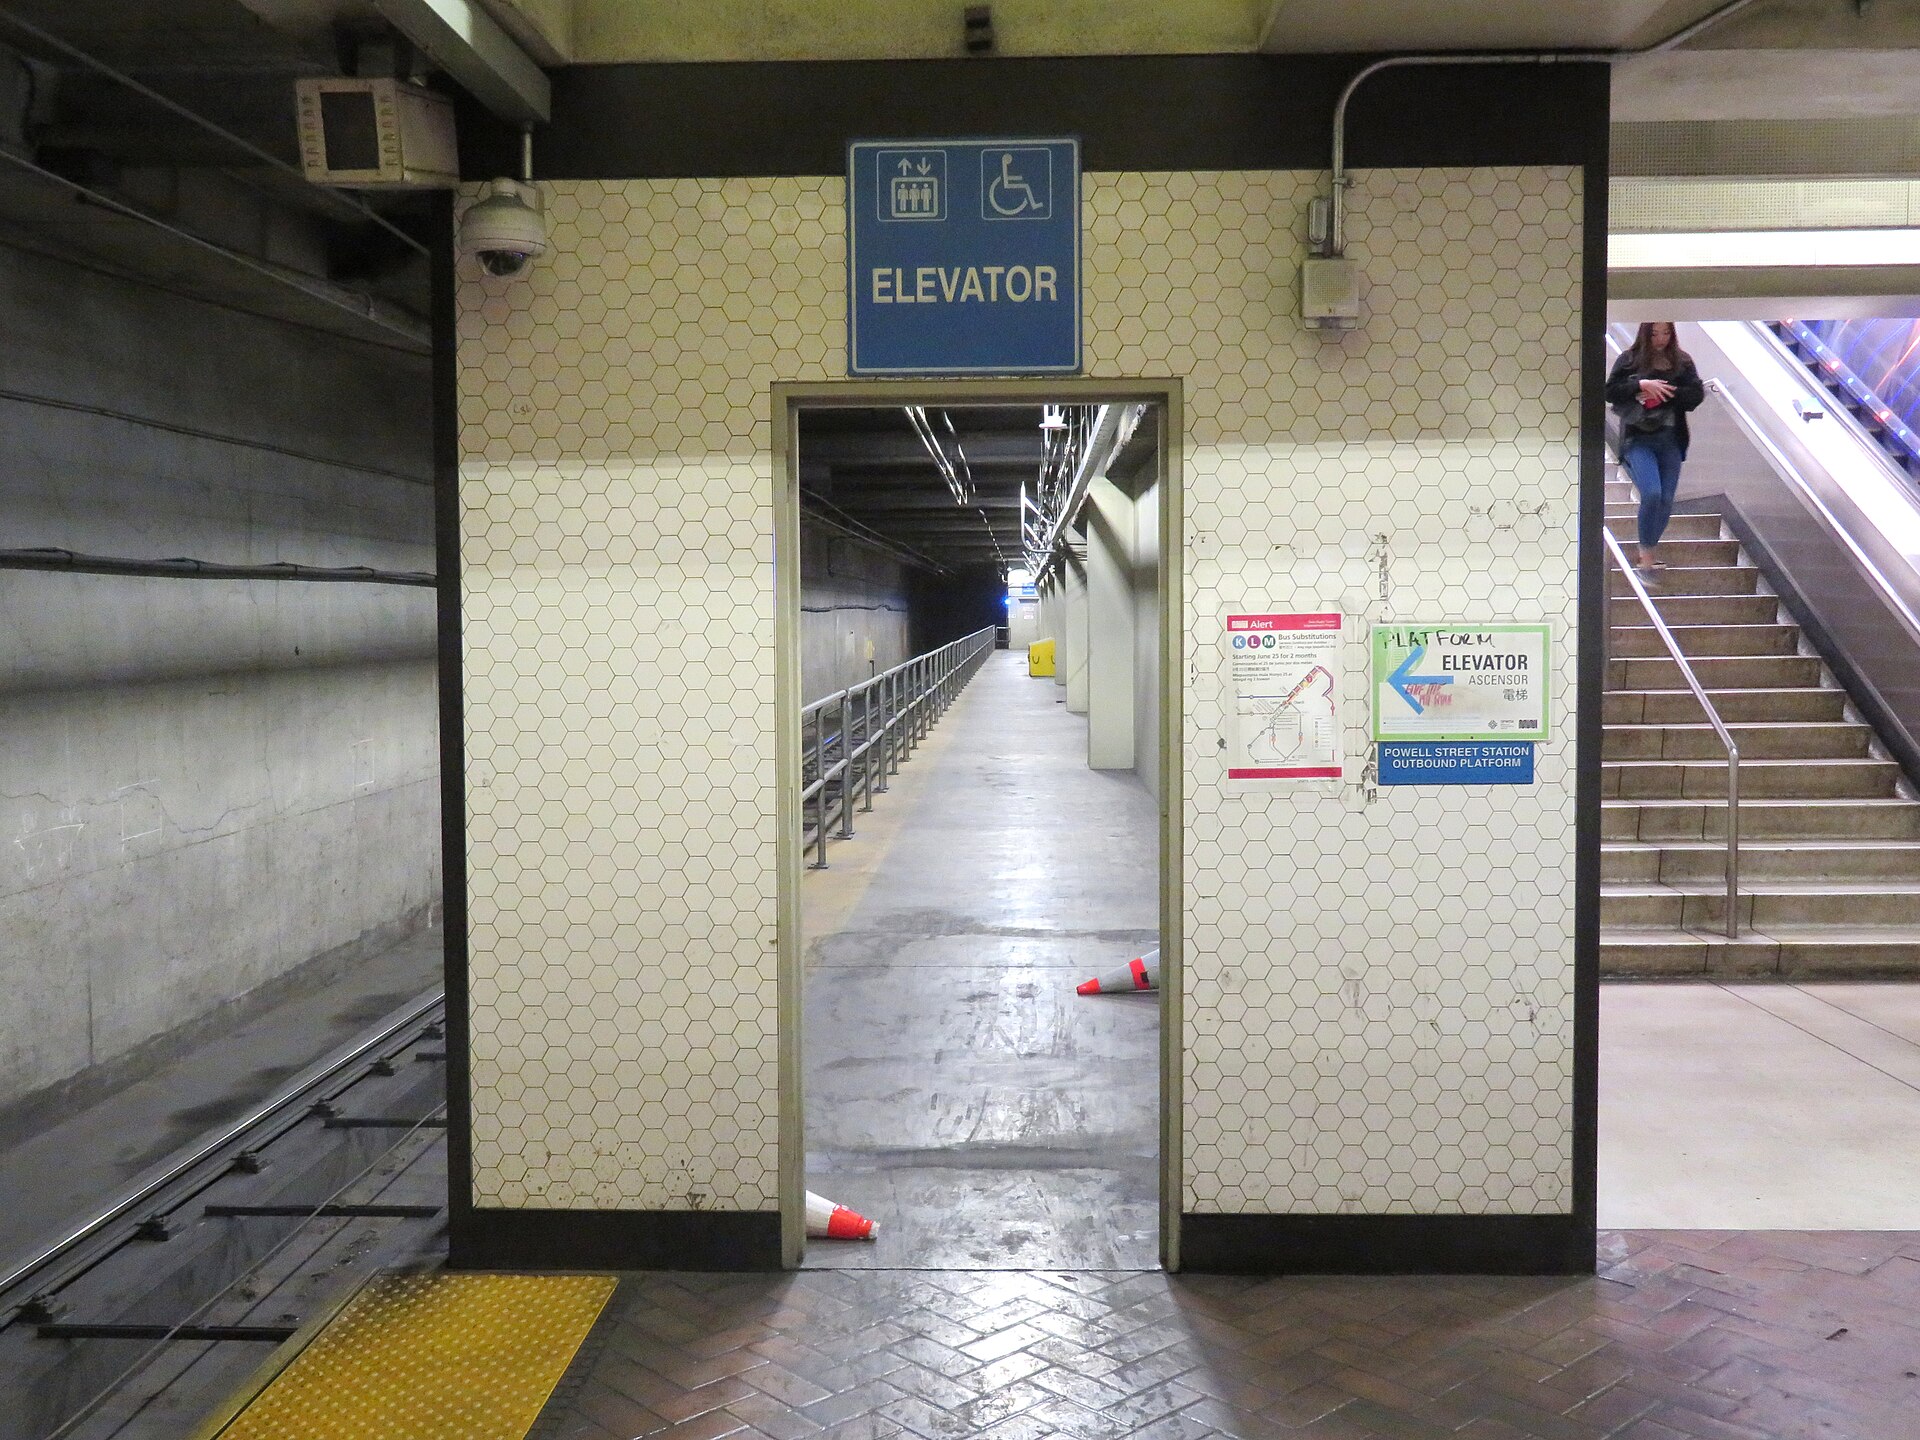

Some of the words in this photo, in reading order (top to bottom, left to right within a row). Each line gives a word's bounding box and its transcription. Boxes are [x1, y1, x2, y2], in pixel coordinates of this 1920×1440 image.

[872, 265, 1058, 304] ELEVATOR
[1250, 620, 1273, 628] Alert
[1379, 630, 1496, 649] PLATFORM
[1442, 654, 1528, 671] ELEVATOR
[1468, 674, 1528, 685] ASCENSOR
[1503, 688, 1529, 701] 電梯
[1384, 748, 1432, 757] POWELL
[1434, 747, 1479, 757] STREET
[1481, 747, 1529, 756] STATION
[1392, 758, 1457, 769] OUTBOUND
[1460, 758, 1521, 768] PLATFORM
